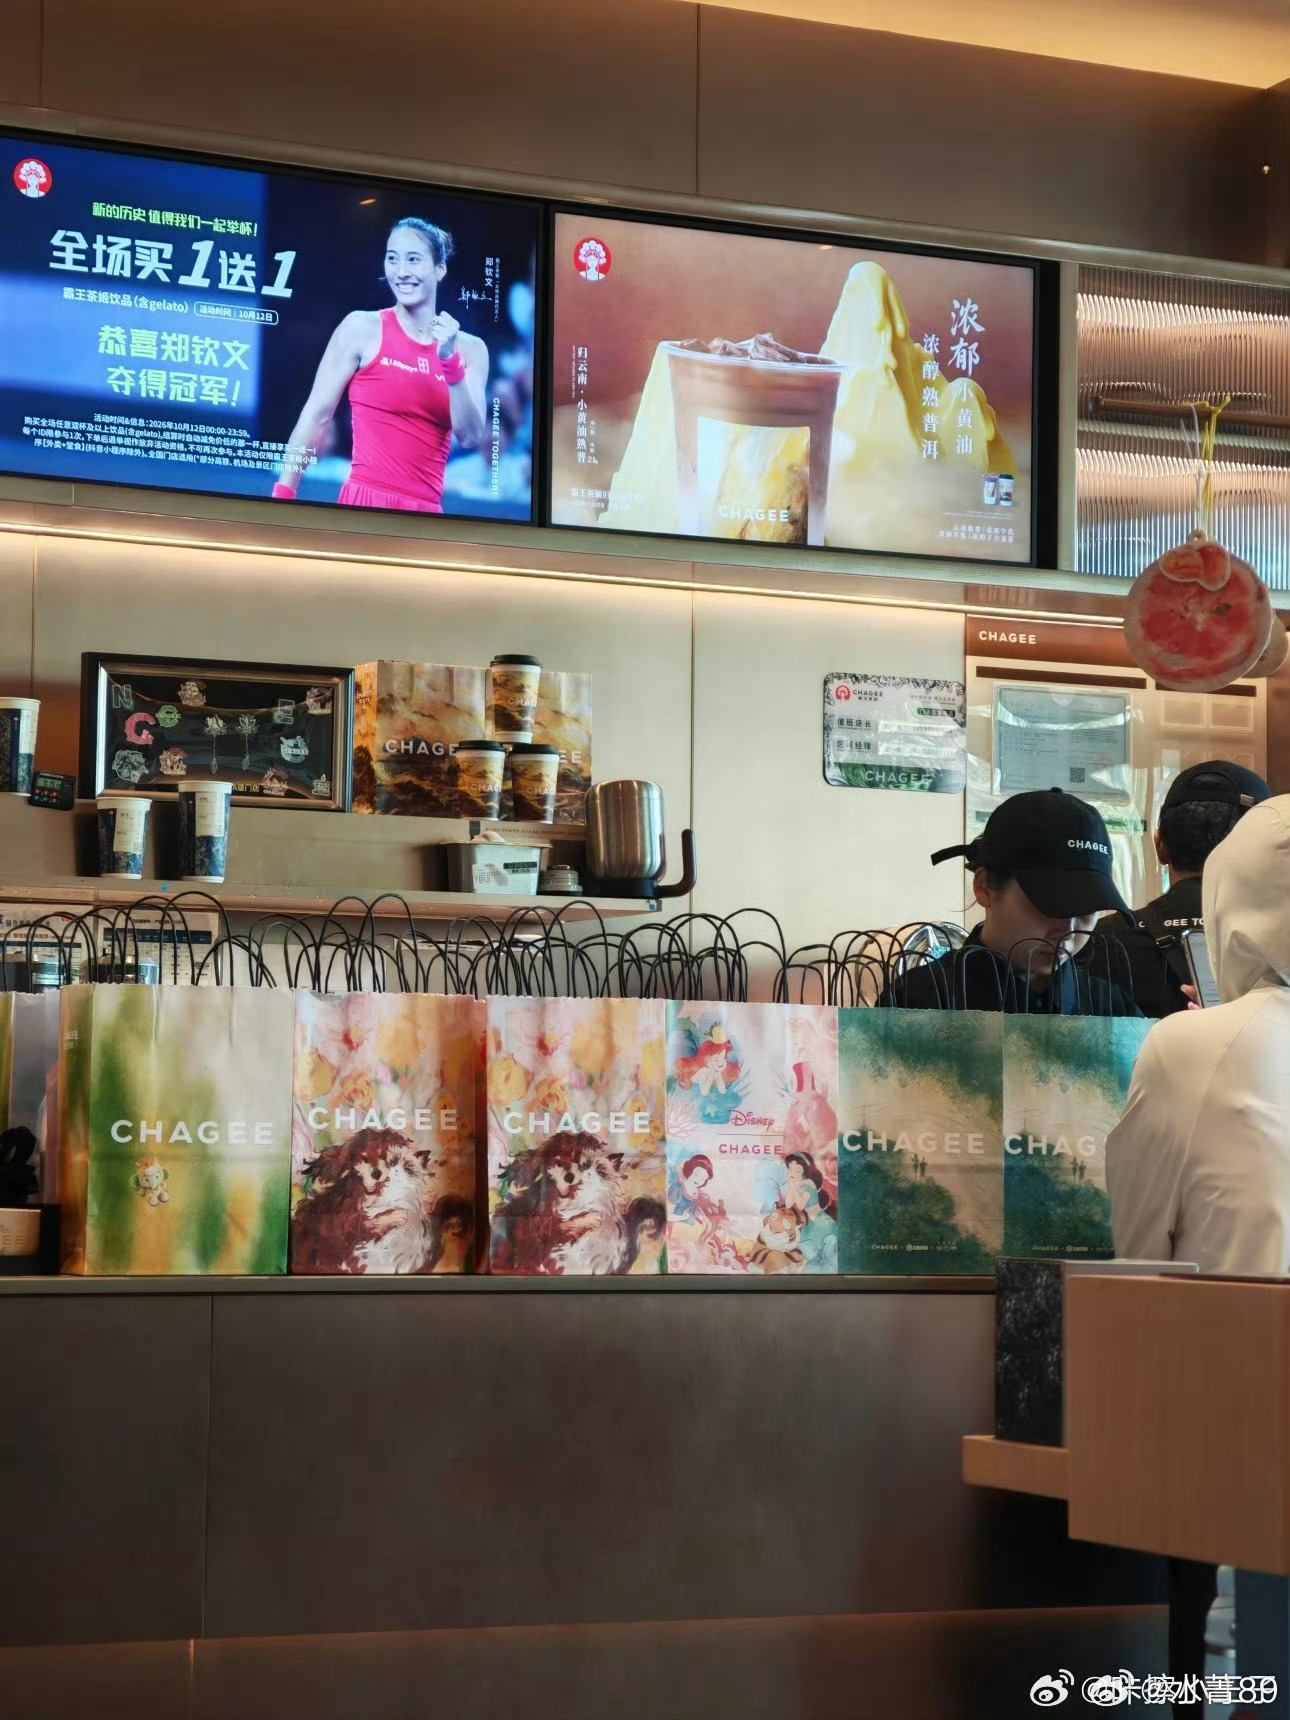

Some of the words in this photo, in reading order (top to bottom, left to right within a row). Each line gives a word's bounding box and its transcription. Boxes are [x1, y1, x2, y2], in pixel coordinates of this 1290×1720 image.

[93, 202, 146, 222] 新的历史
[49, 229, 296, 298] 全场买1送1
[238, 309, 273, 323] 10月12日
[98, 325, 251, 371] 恭喜郑钦文
[947, 298, 986, 377] 浓郁
[922, 333, 940, 459] 浓醇熟普洱
[956, 382, 974, 454] 小黄油
[718, 505, 790, 523] CHAGEE
[978, 630, 1037, 645] CHAGEE
[853, 689, 883, 697] CHAGEE
[385, 739, 459, 757] CHAGE
[1067, 839, 1109, 855] CHAGEE
[308, 1106, 458, 1131] CHAGEE
[503, 1111, 651, 1134] CHAGEE
[110, 1119, 274, 1146] CHAGEE
[842, 1129, 985, 1154] CHAGEE
[718, 1143, 782, 1155] CHAGEE
[1004, 1133, 1106, 1156] CHAG
